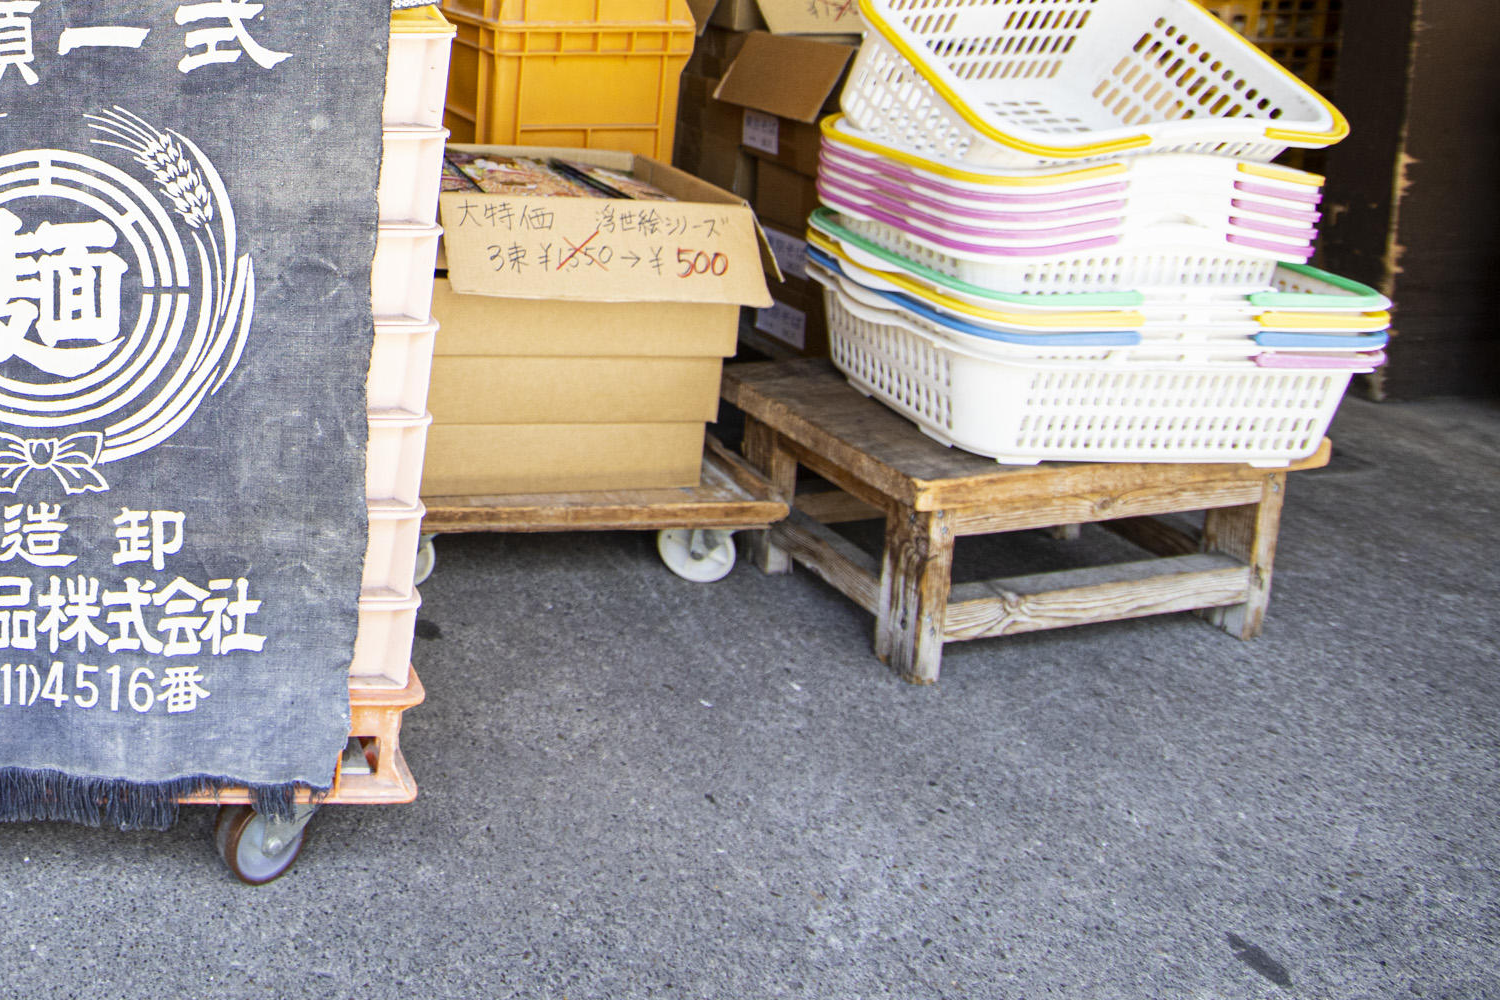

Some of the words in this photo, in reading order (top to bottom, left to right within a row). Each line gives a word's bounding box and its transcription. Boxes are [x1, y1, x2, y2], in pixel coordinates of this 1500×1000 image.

[457, 198, 555, 232] 大特価
[596, 202, 730, 238] 浮世絵シリーズ
